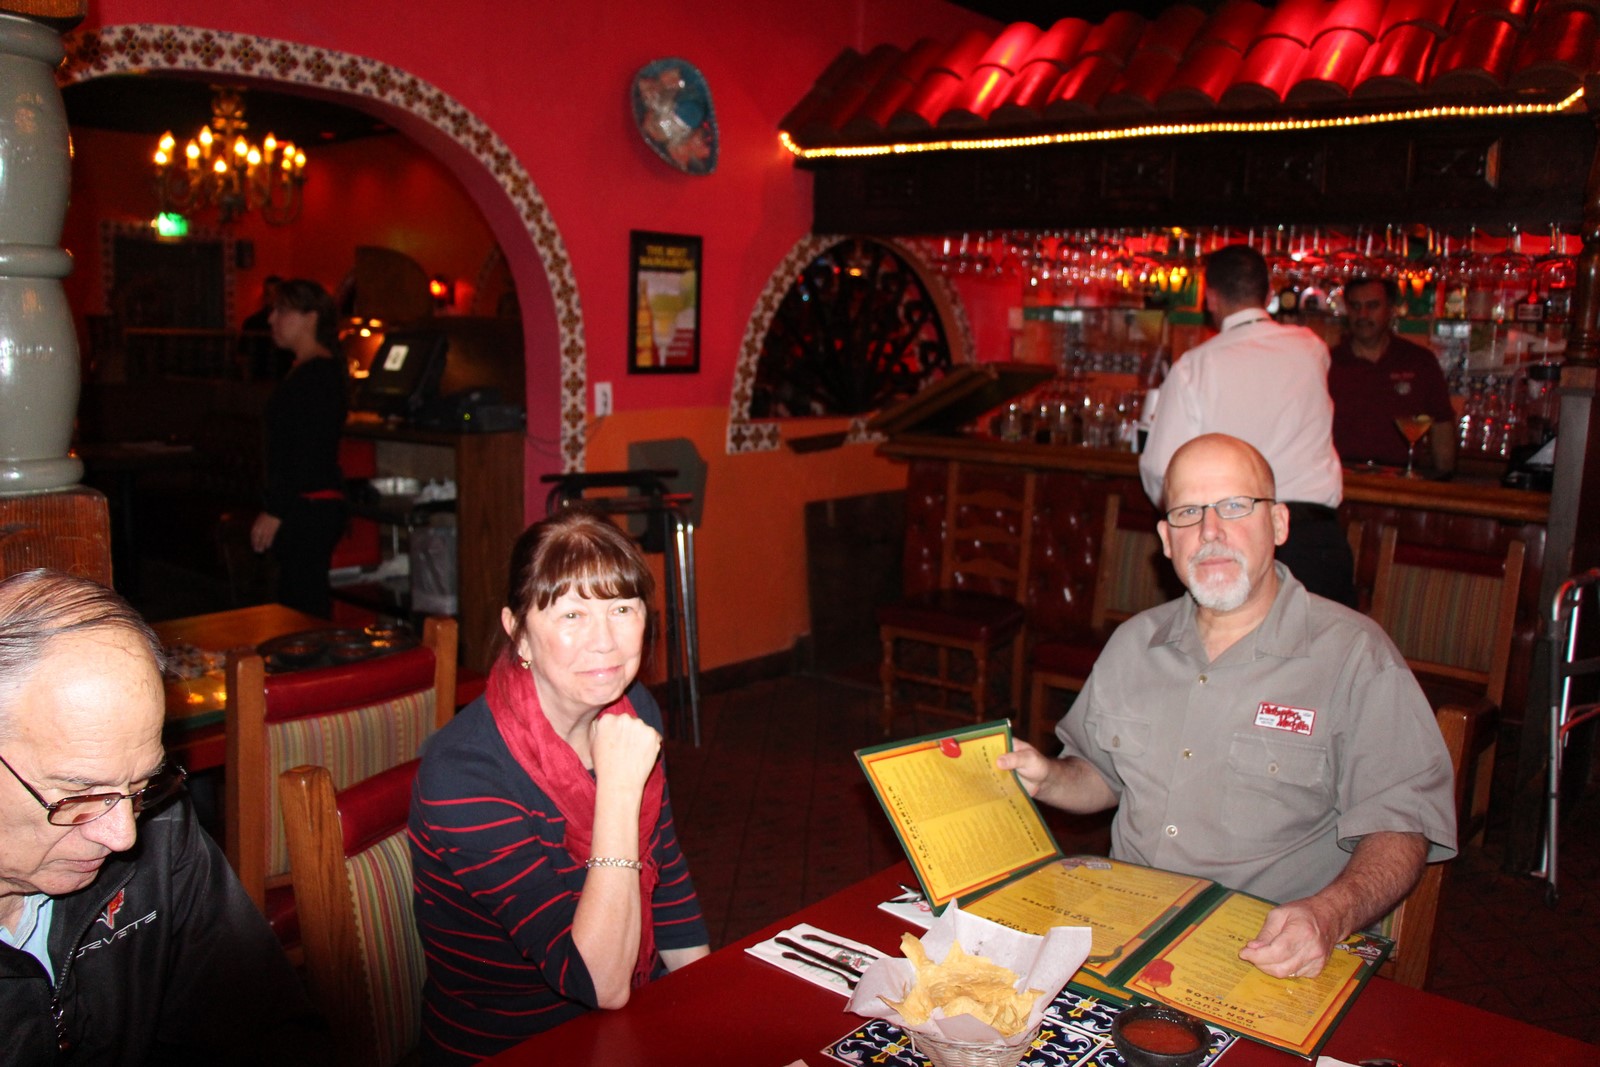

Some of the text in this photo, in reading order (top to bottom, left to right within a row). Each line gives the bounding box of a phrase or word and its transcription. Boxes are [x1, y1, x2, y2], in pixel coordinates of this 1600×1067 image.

[1183, 996, 1253, 1023] DON CUCO
[1184, 988, 1264, 1019] APERITIVOS
